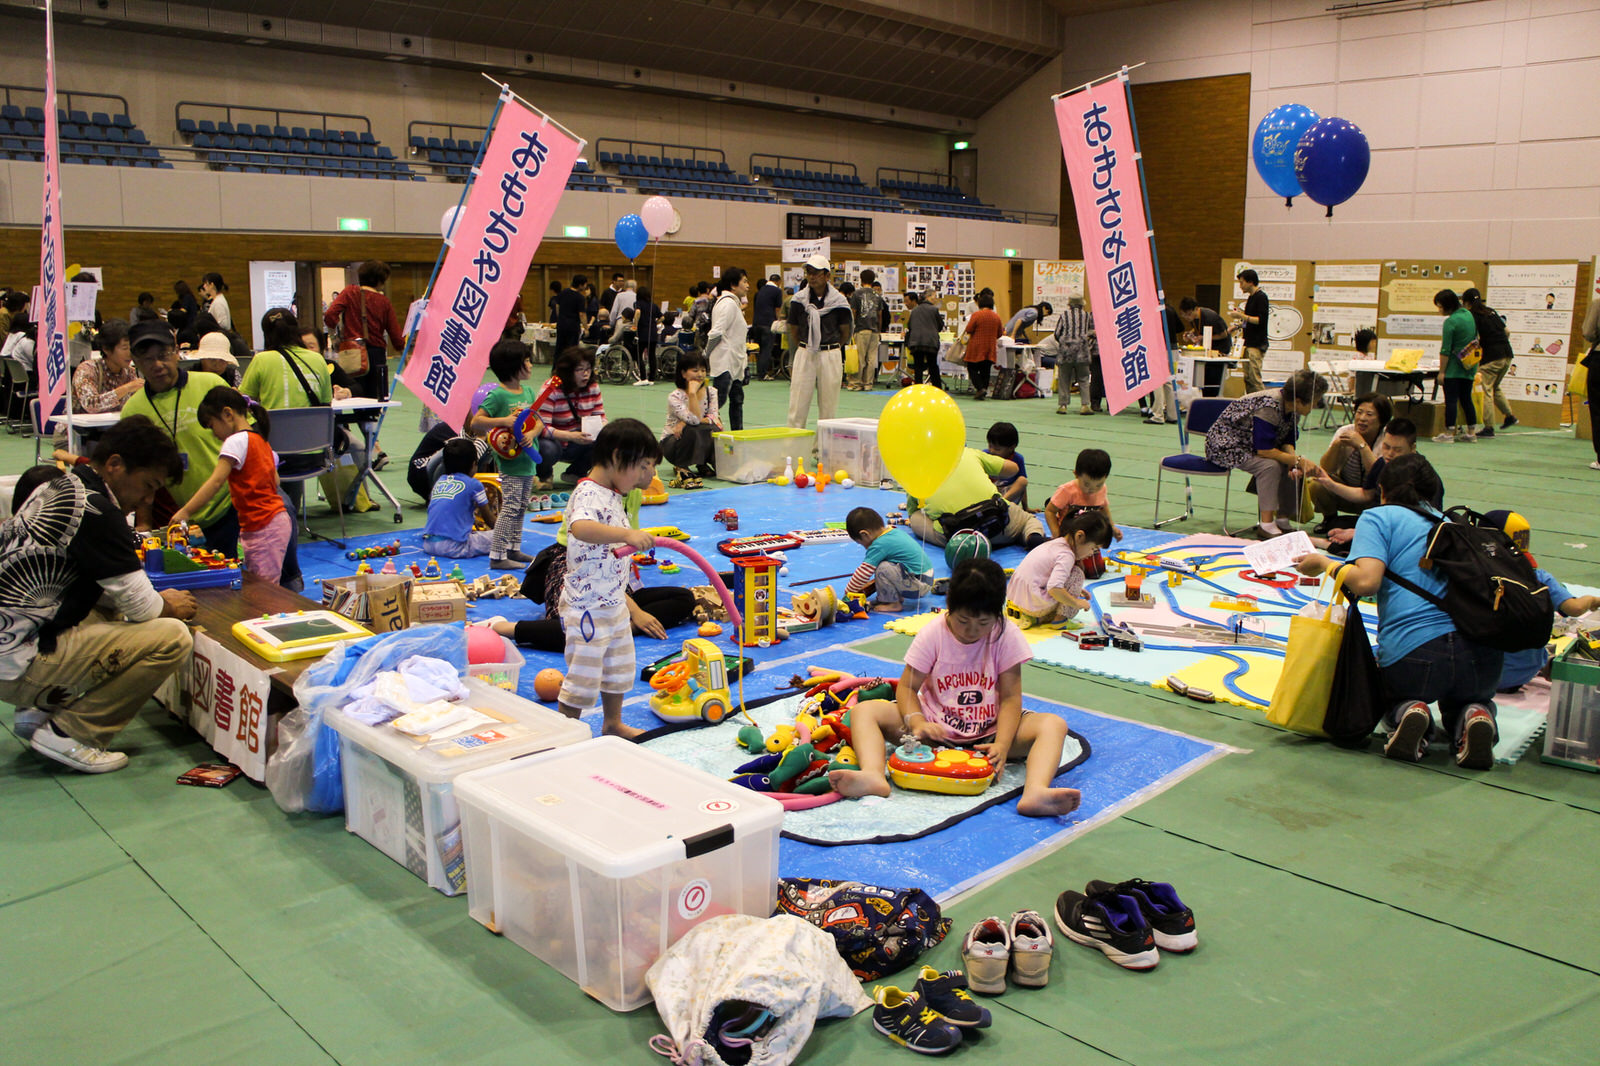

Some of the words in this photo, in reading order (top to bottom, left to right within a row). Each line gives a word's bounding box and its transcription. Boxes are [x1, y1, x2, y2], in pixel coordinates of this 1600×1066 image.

[423, 131, 548, 405] おもちゃ図書館
[915, 226, 926, 248] 西
[193, 651, 263, 754] 図書館
[963, 691, 977, 703] 75
